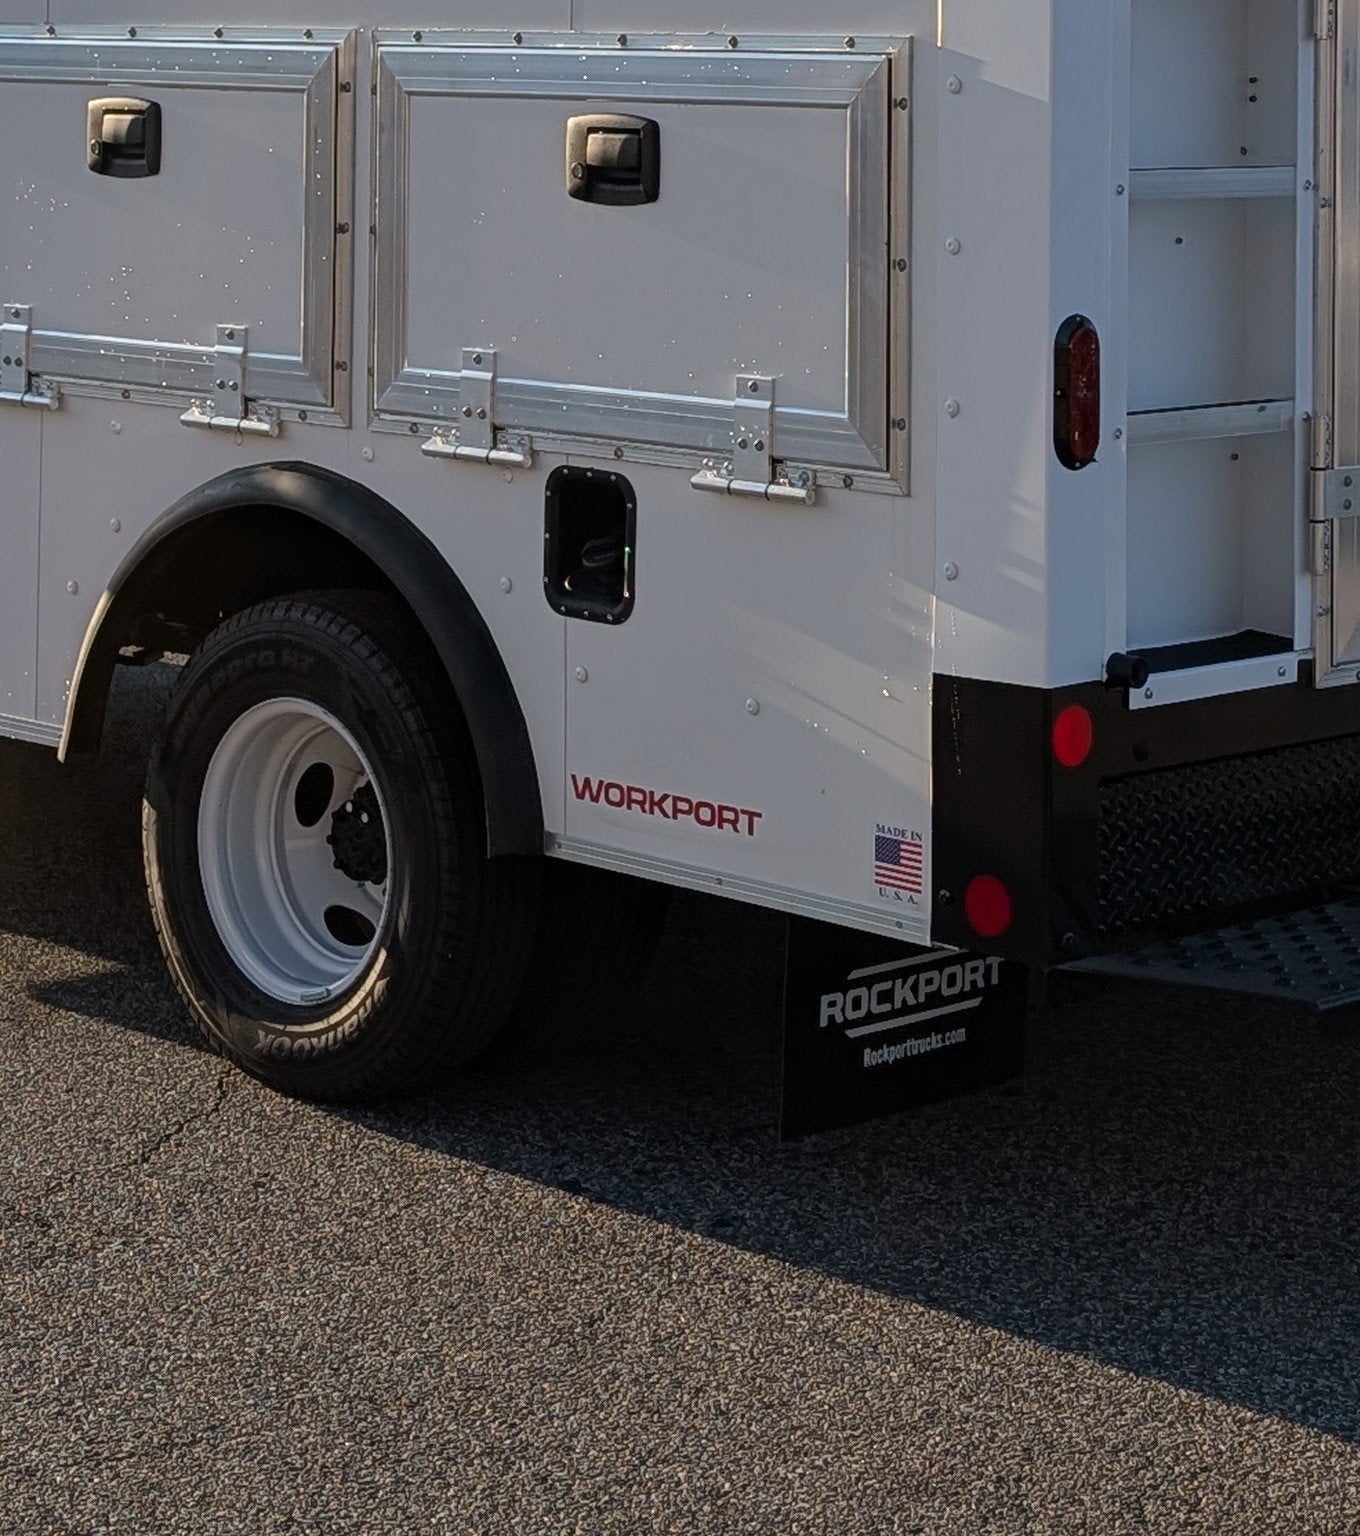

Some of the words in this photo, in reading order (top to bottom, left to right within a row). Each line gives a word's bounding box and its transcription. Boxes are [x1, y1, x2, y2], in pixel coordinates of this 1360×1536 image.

[570, 773, 763, 837] WORKPORT
[876, 823, 908, 839] MADE
[911, 831, 922, 841] IN
[819, 956, 1006, 1028] ROCKPORT
[863, 1027, 967, 1068] Rockporttrucks.com
